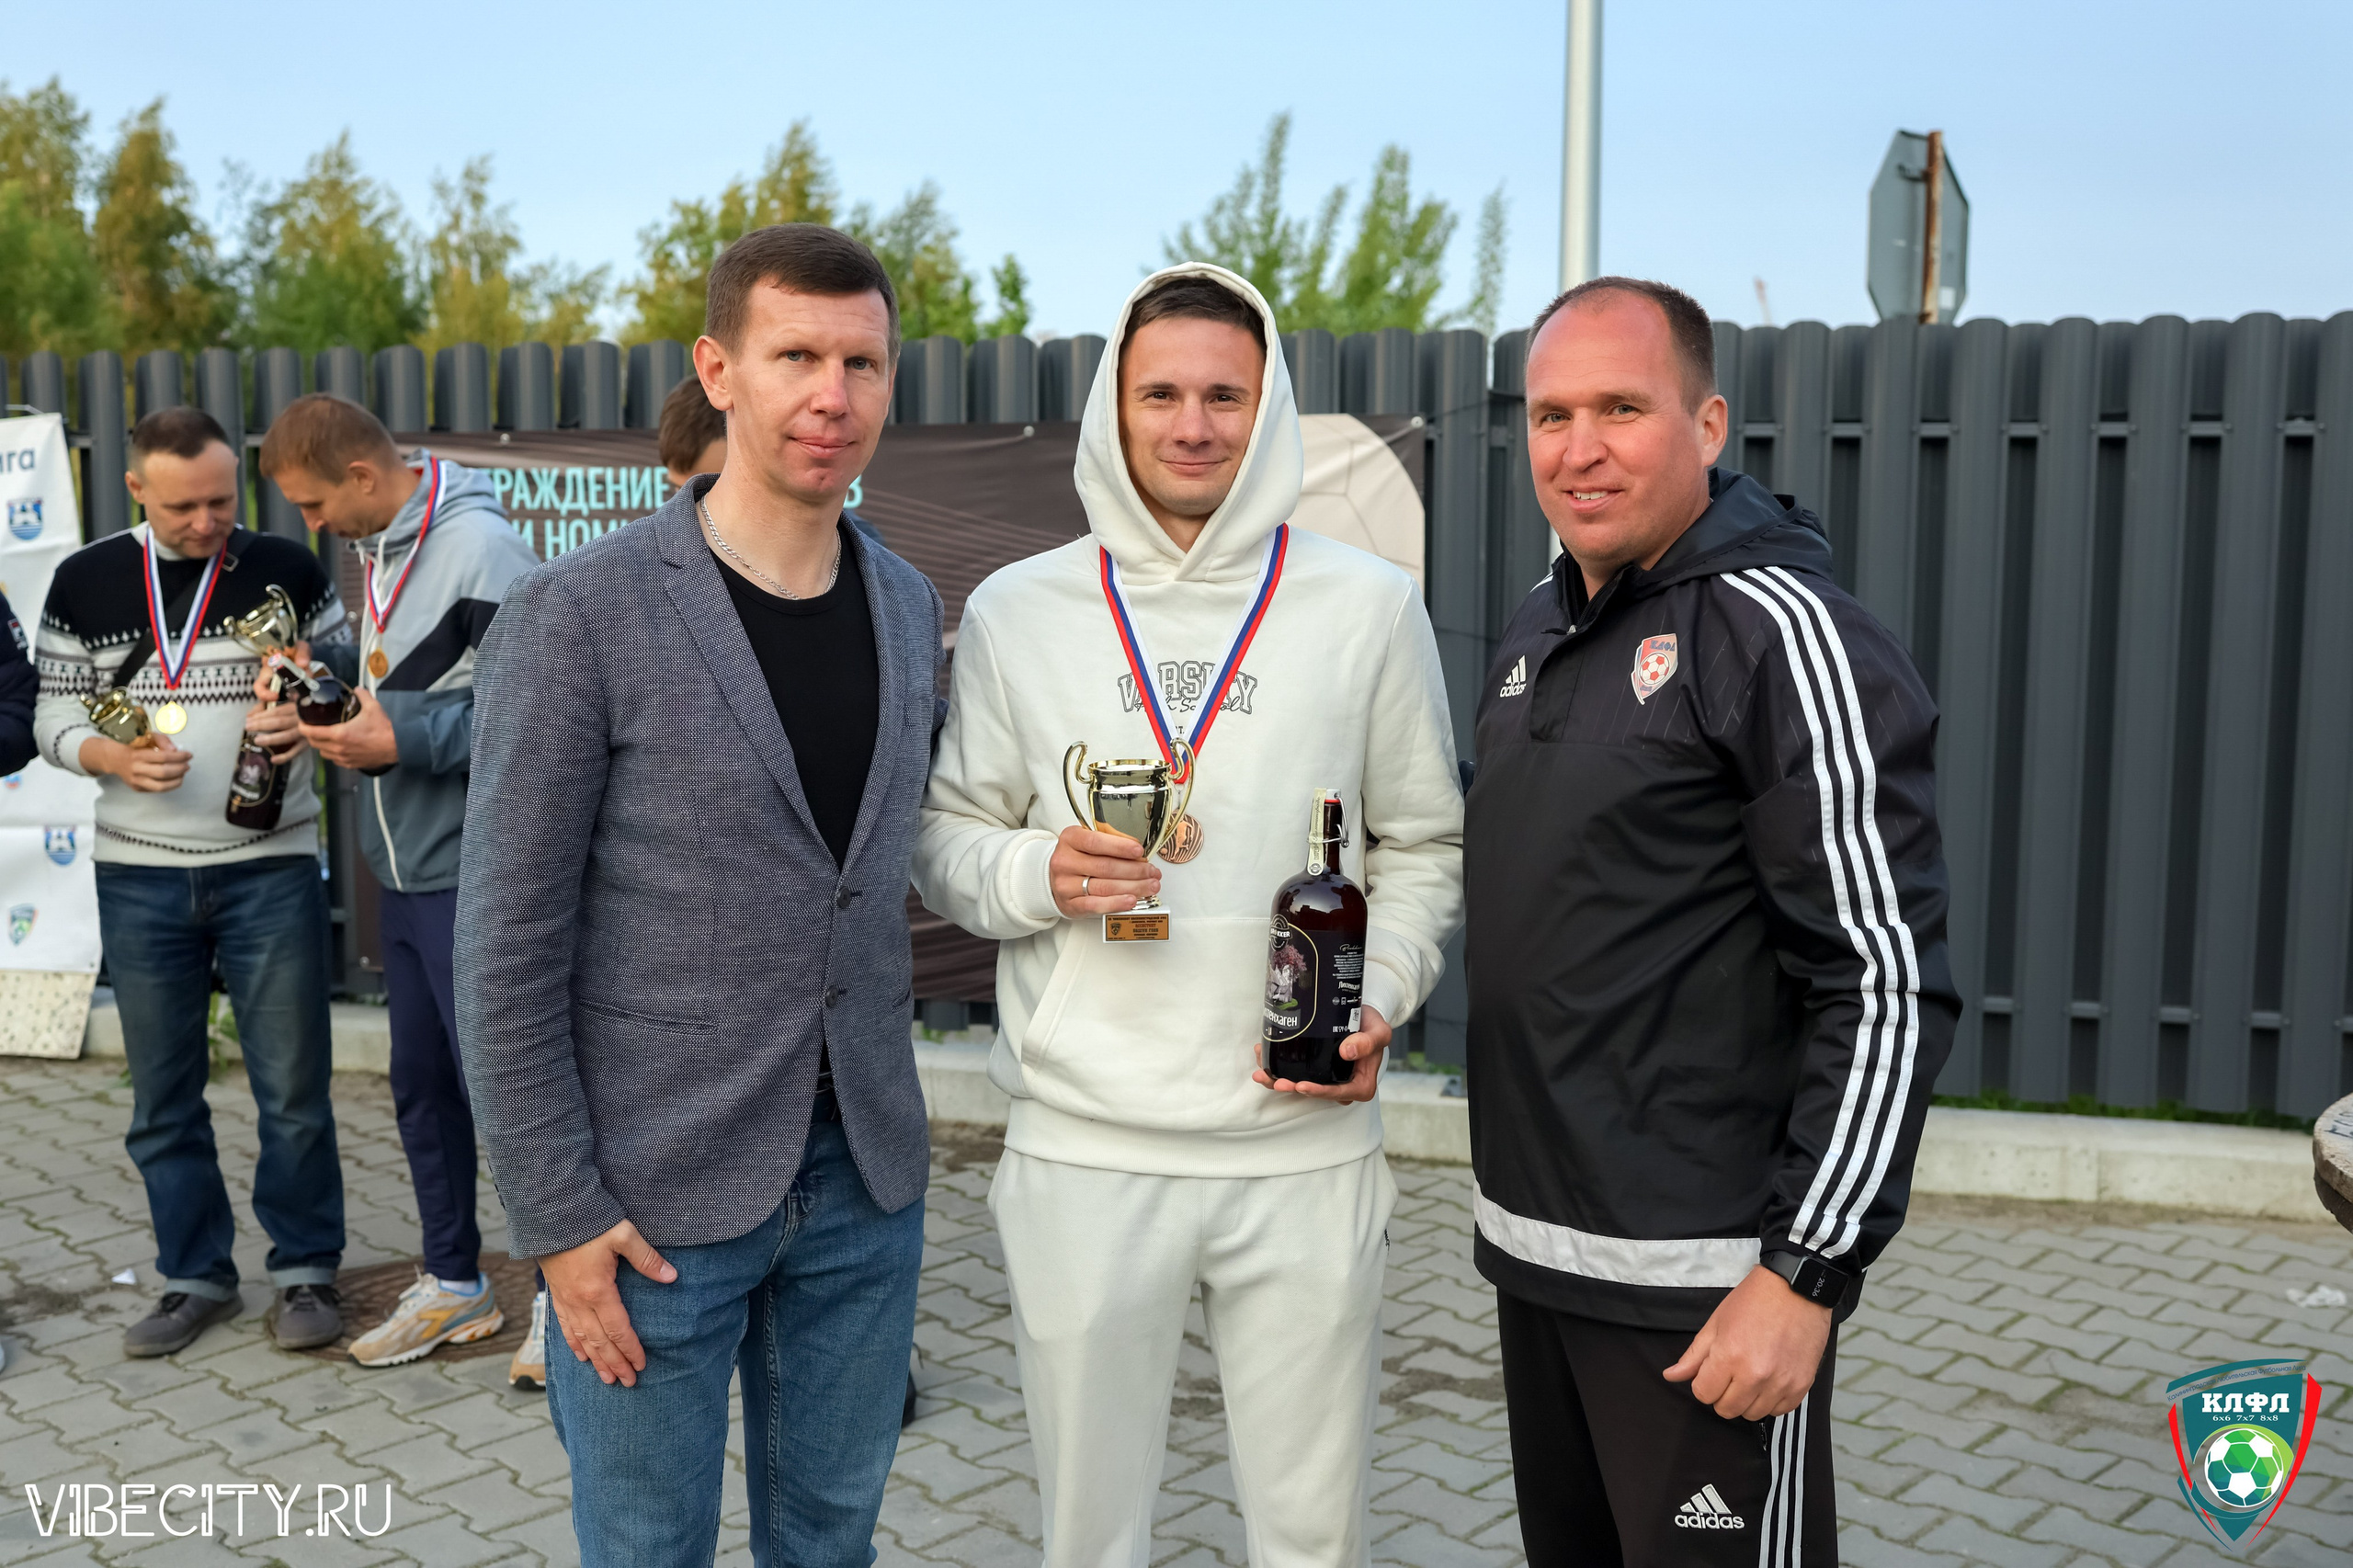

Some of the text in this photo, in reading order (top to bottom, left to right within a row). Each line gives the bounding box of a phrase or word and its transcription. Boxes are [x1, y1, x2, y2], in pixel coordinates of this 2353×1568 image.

[481, 467, 670, 517] РАЖДЕНИЕ
[544, 518, 630, 562] НО
[1118, 660, 1258, 715] VRSIY
[1500, 682, 1527, 698] adidas
[1812, 1277, 1825, 1297] 20:36
[1674, 1511, 1745, 1529] adidas
